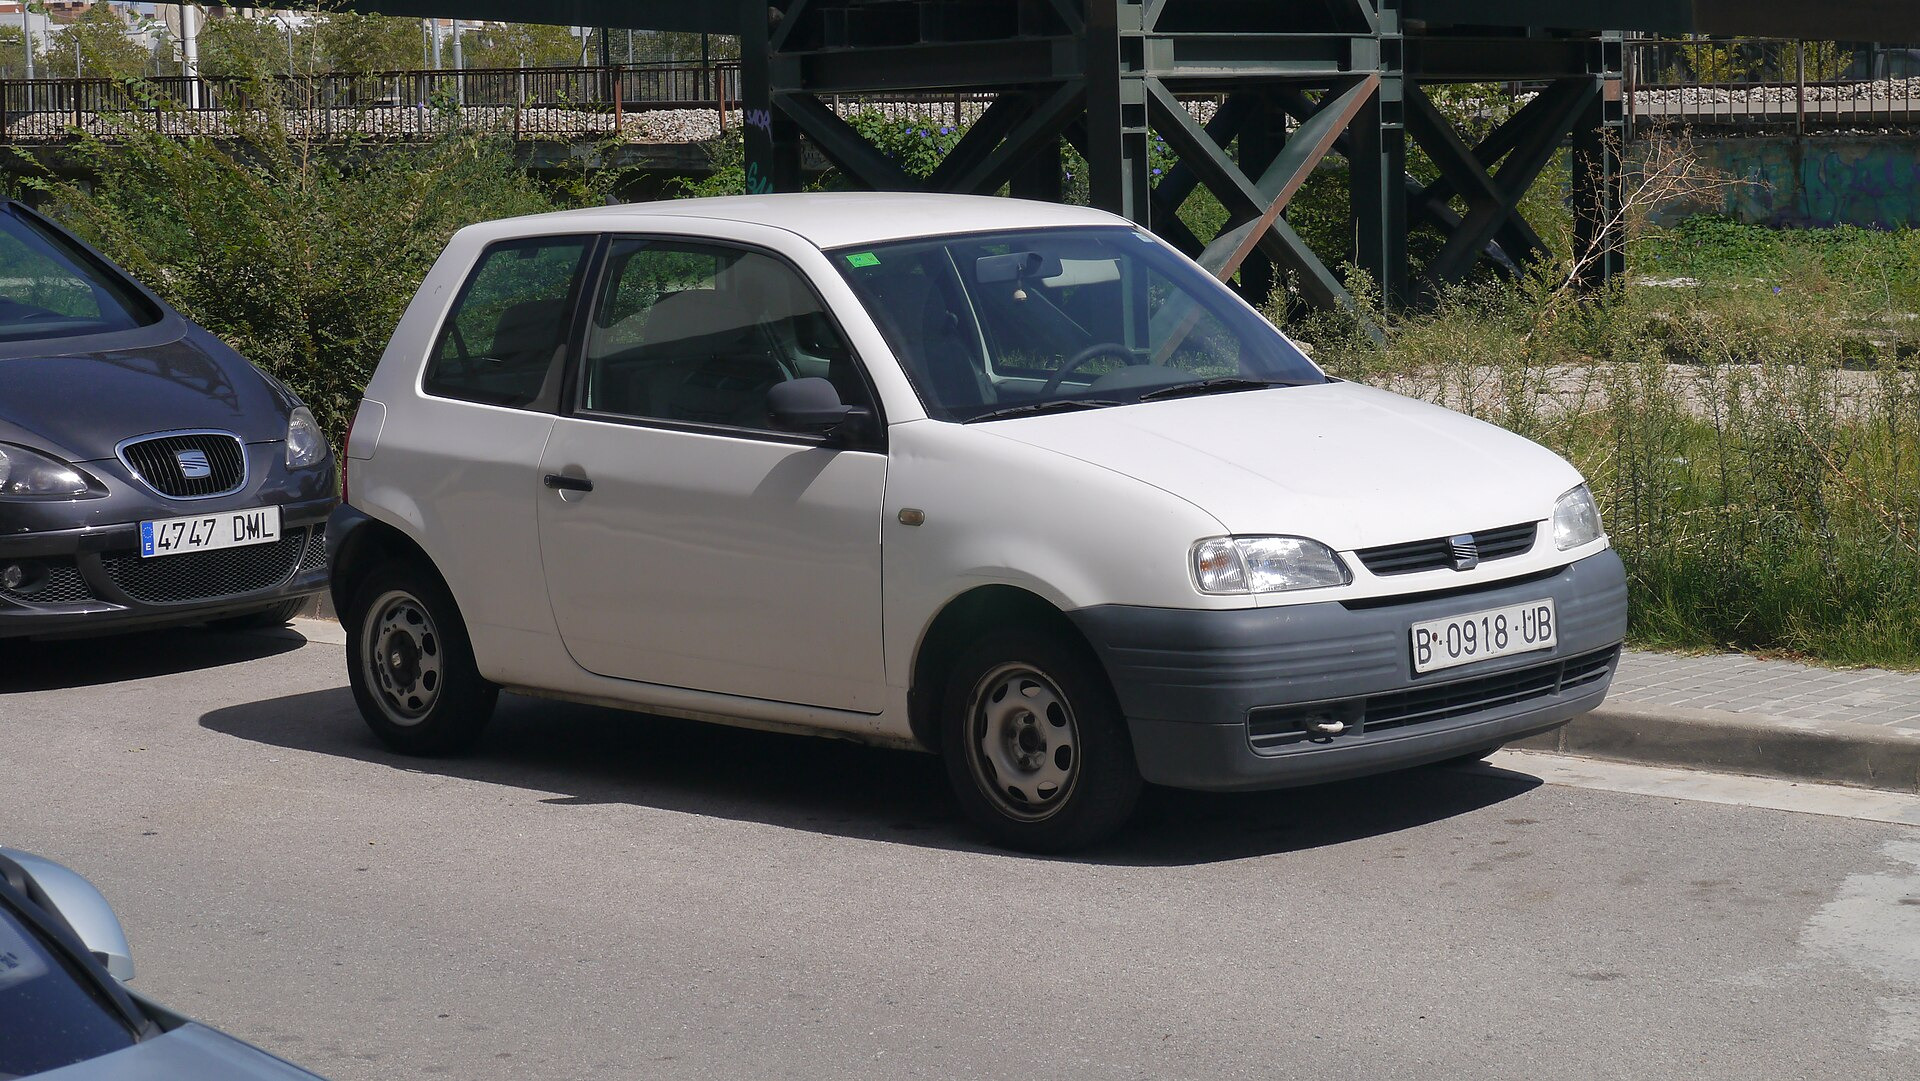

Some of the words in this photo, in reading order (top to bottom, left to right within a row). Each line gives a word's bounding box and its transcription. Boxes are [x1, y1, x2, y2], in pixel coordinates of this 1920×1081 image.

[158, 518, 216, 550] 4747
[233, 512, 274, 542] DML
[145, 543, 151, 551] E
